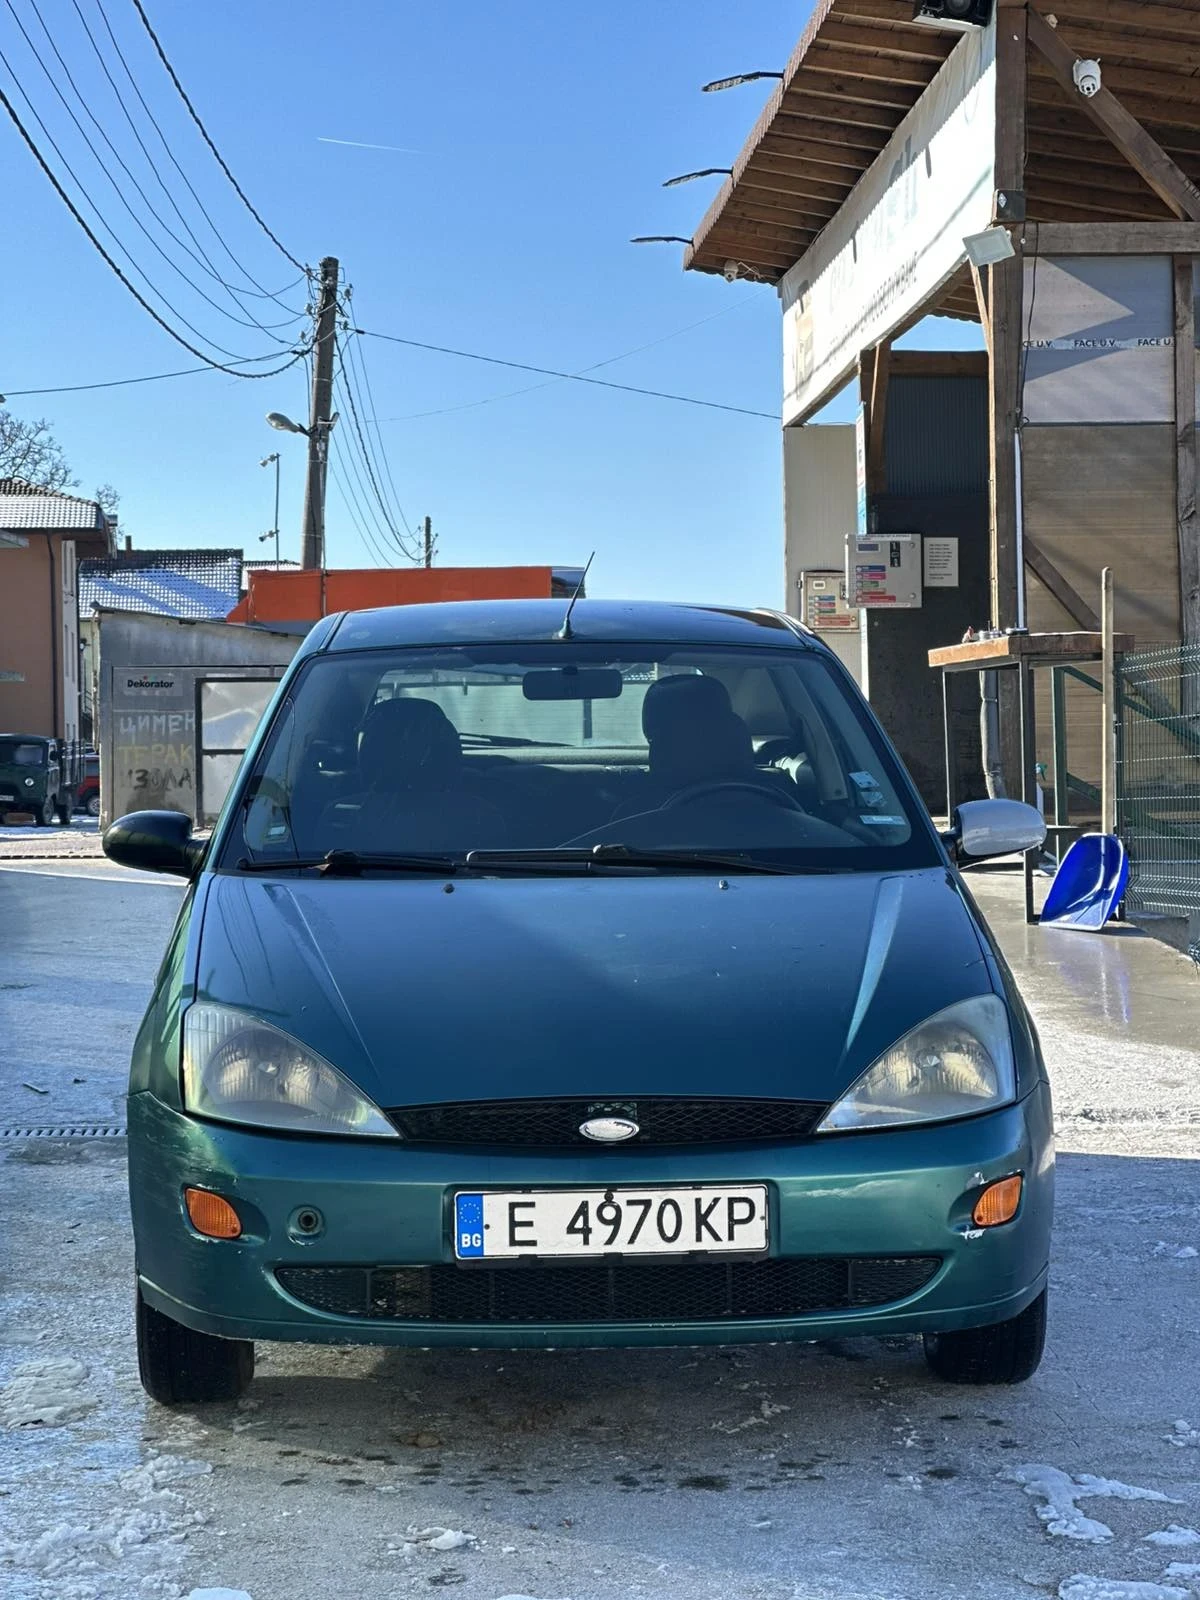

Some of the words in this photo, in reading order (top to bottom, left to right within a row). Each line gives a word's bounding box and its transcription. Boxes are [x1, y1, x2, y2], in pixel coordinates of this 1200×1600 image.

[1074, 339, 1097, 347] FACE
[1137, 338, 1161, 346] FACE
[127, 679, 174, 689] Dekorator
[508, 1201, 538, 1247] E
[566, 1197, 683, 1246] 4970
[695, 1196, 756, 1243] KP
[461, 1232, 481, 1248] BG
